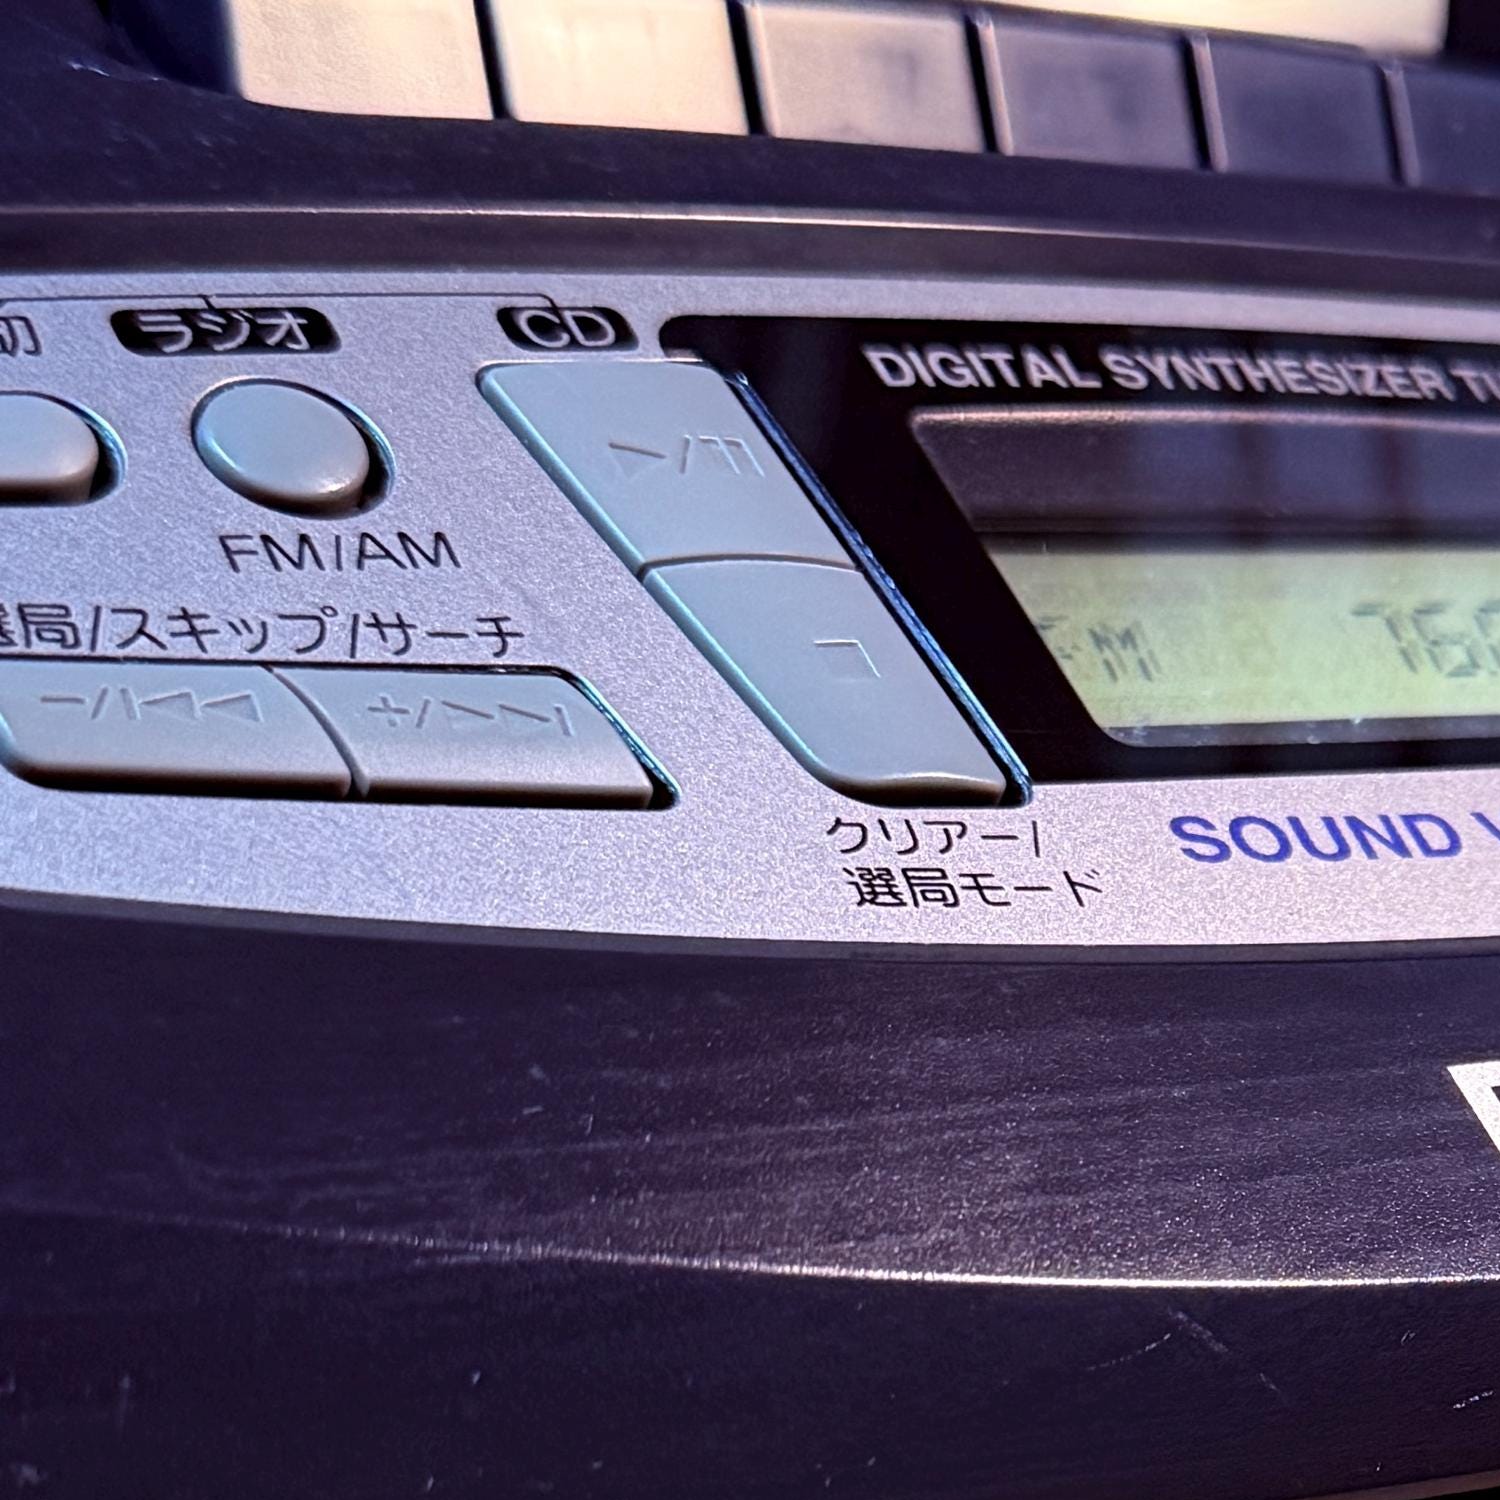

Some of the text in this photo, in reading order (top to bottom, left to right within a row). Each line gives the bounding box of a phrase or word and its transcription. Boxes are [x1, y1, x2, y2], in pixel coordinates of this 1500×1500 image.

[139, 312, 312, 353] ラジオ
[515, 309, 616, 349] CD
[863, 345, 1104, 390] DIGITAL
[1102, 350, 1447, 400] SYNTHESIZER
[219, 531, 461, 573] FM/AM
[826, 817, 1041, 858] クリアー/
[1170, 813, 1463, 863] SOUND
[842, 867, 1103, 908] 選局モード
